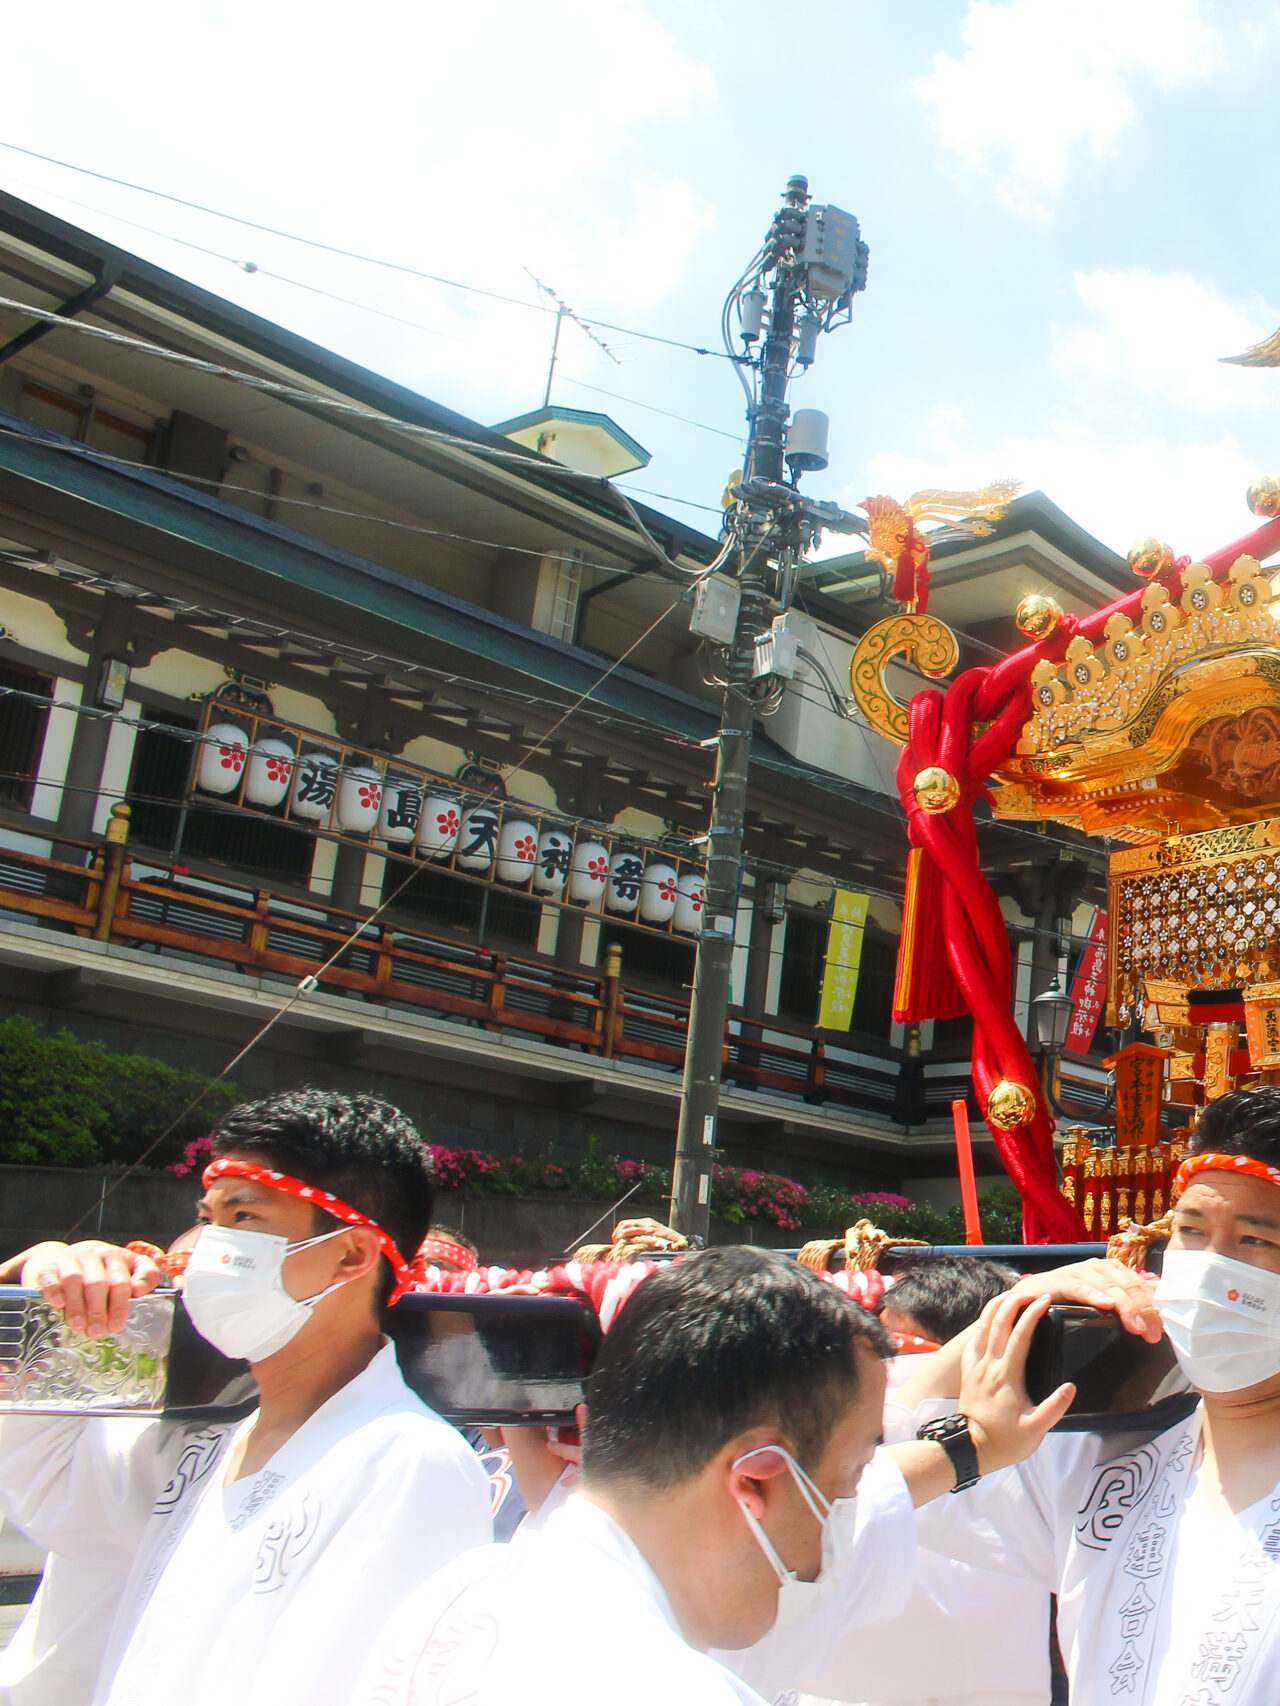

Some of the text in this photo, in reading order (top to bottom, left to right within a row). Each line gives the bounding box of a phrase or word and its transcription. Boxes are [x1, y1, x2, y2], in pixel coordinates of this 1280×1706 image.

[297, 765, 645, 902] 湯島天神祭
